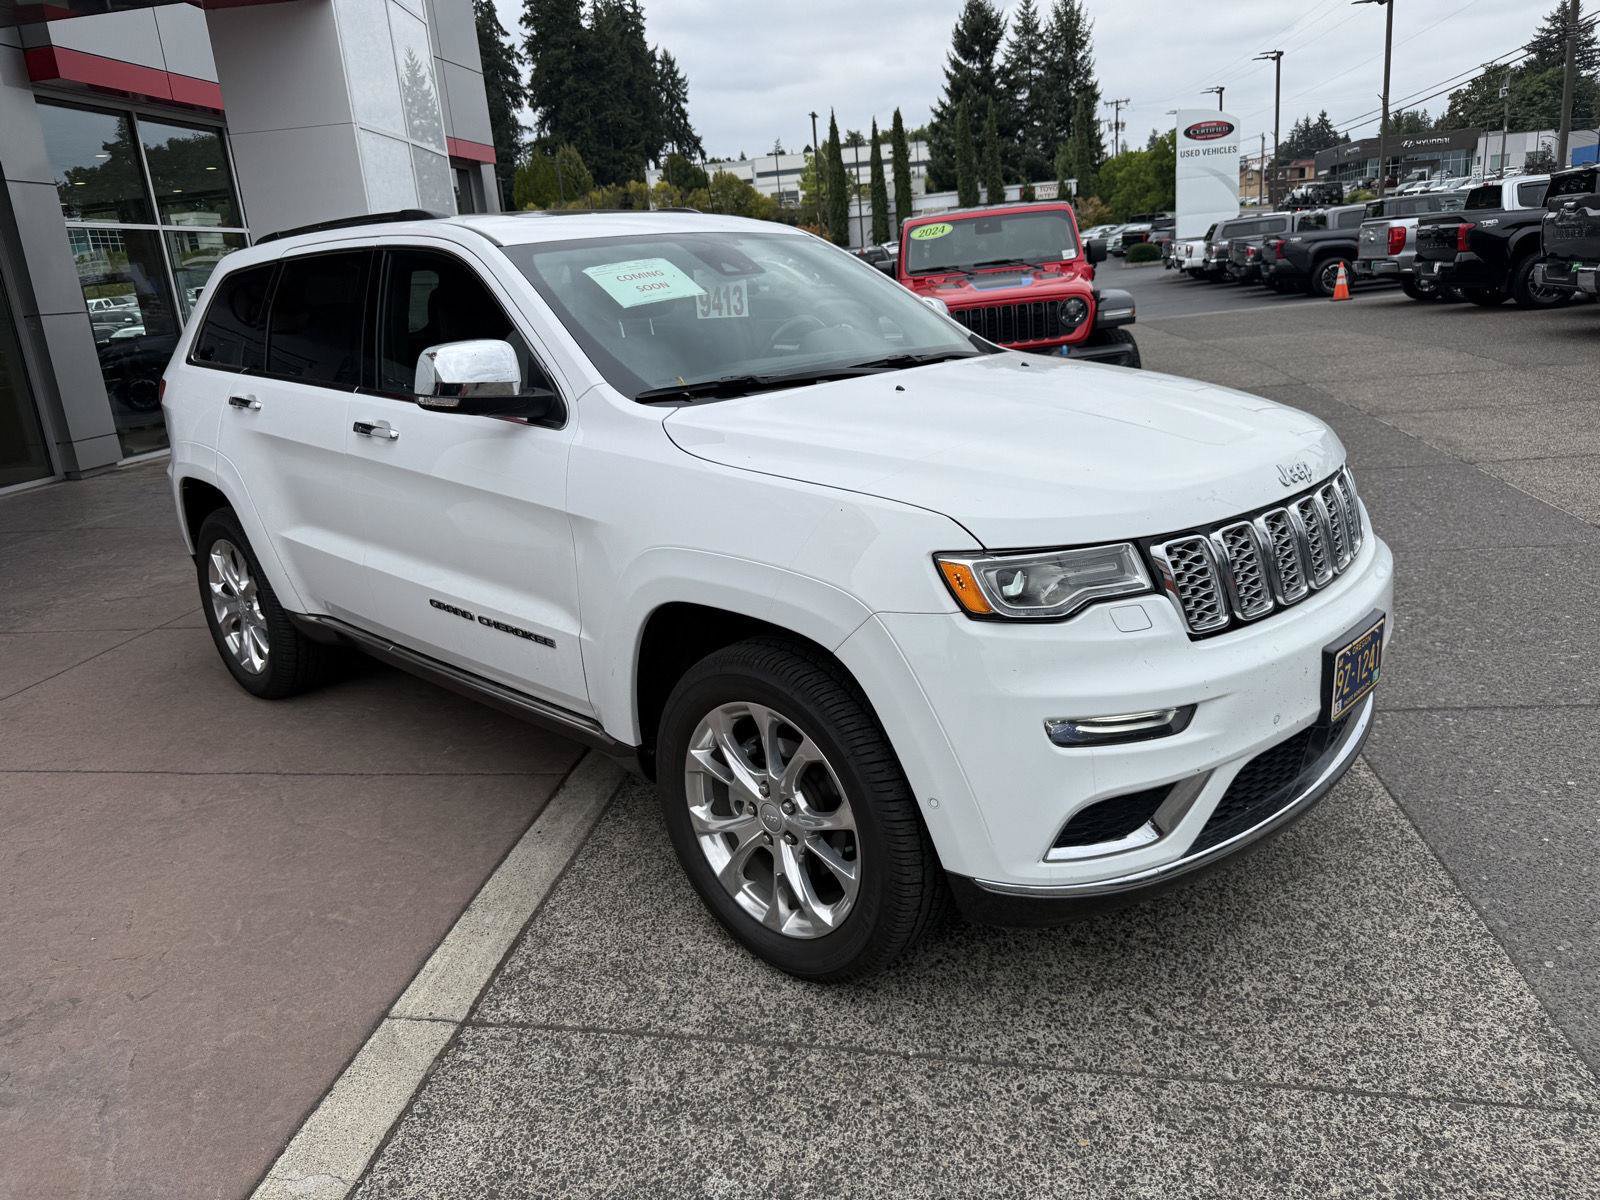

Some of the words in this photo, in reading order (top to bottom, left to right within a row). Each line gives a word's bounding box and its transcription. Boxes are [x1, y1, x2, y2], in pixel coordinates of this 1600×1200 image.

[1190, 126, 1228, 135] CERTIFIED
[1180, 149, 1200, 158] USED
[1202, 145, 1237, 156] VEHICLES
[918, 225, 946, 238] 2024
[616, 269, 664, 283] COMING
[635, 281, 670, 293] SOON
[700, 285, 745, 317] 9413
[1275, 459, 1313, 487] Jeep
[429, 599, 475, 621] GRAND
[478, 616, 557, 649] CHEROKEE
